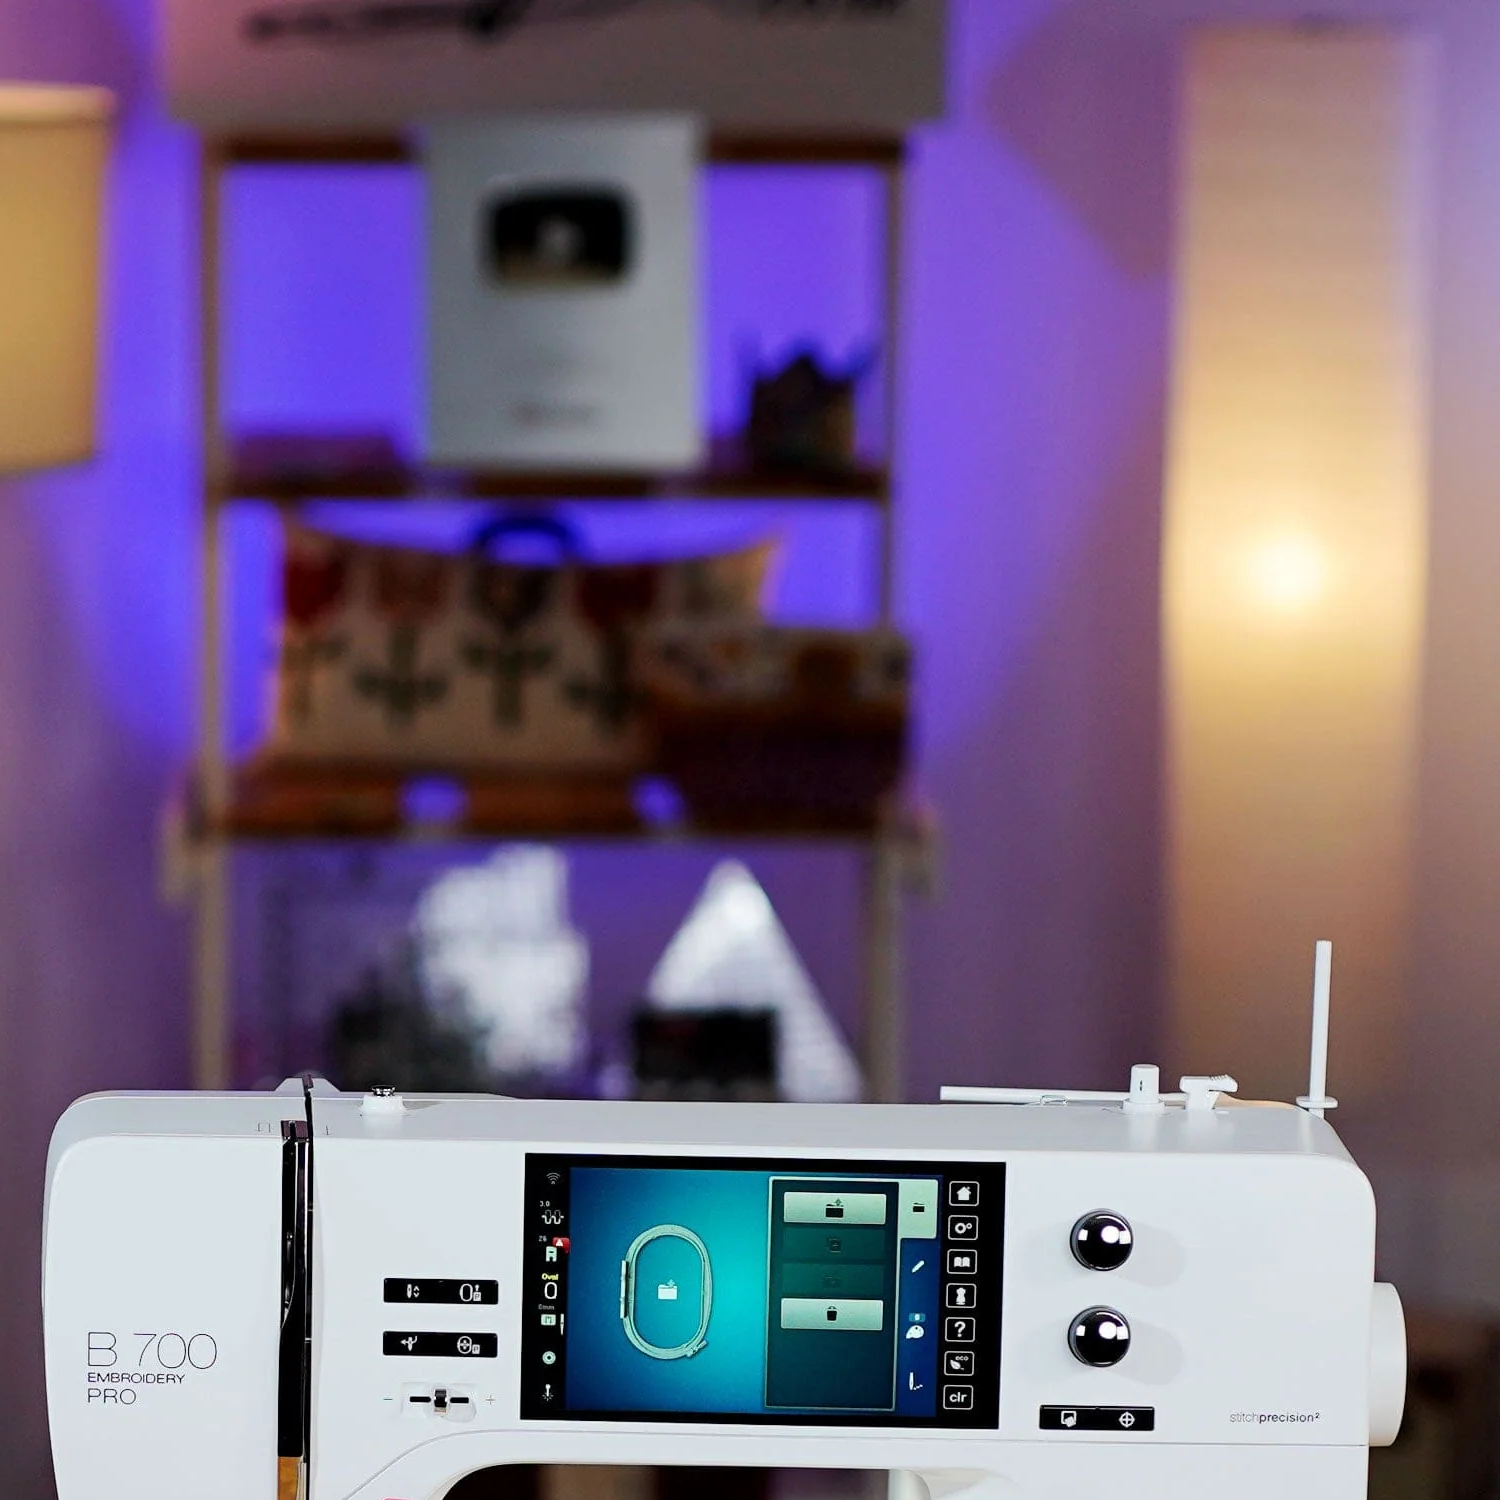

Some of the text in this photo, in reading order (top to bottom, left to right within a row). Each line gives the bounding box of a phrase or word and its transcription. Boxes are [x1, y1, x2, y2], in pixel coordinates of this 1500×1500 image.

[542, 1273, 559, 1281] Oval
[88, 1332, 217, 1369] B 700
[87, 1372, 186, 1384] EMBROIDERY
[87, 1388, 136, 1404] PRO
[949, 1392, 967, 1402] clr
